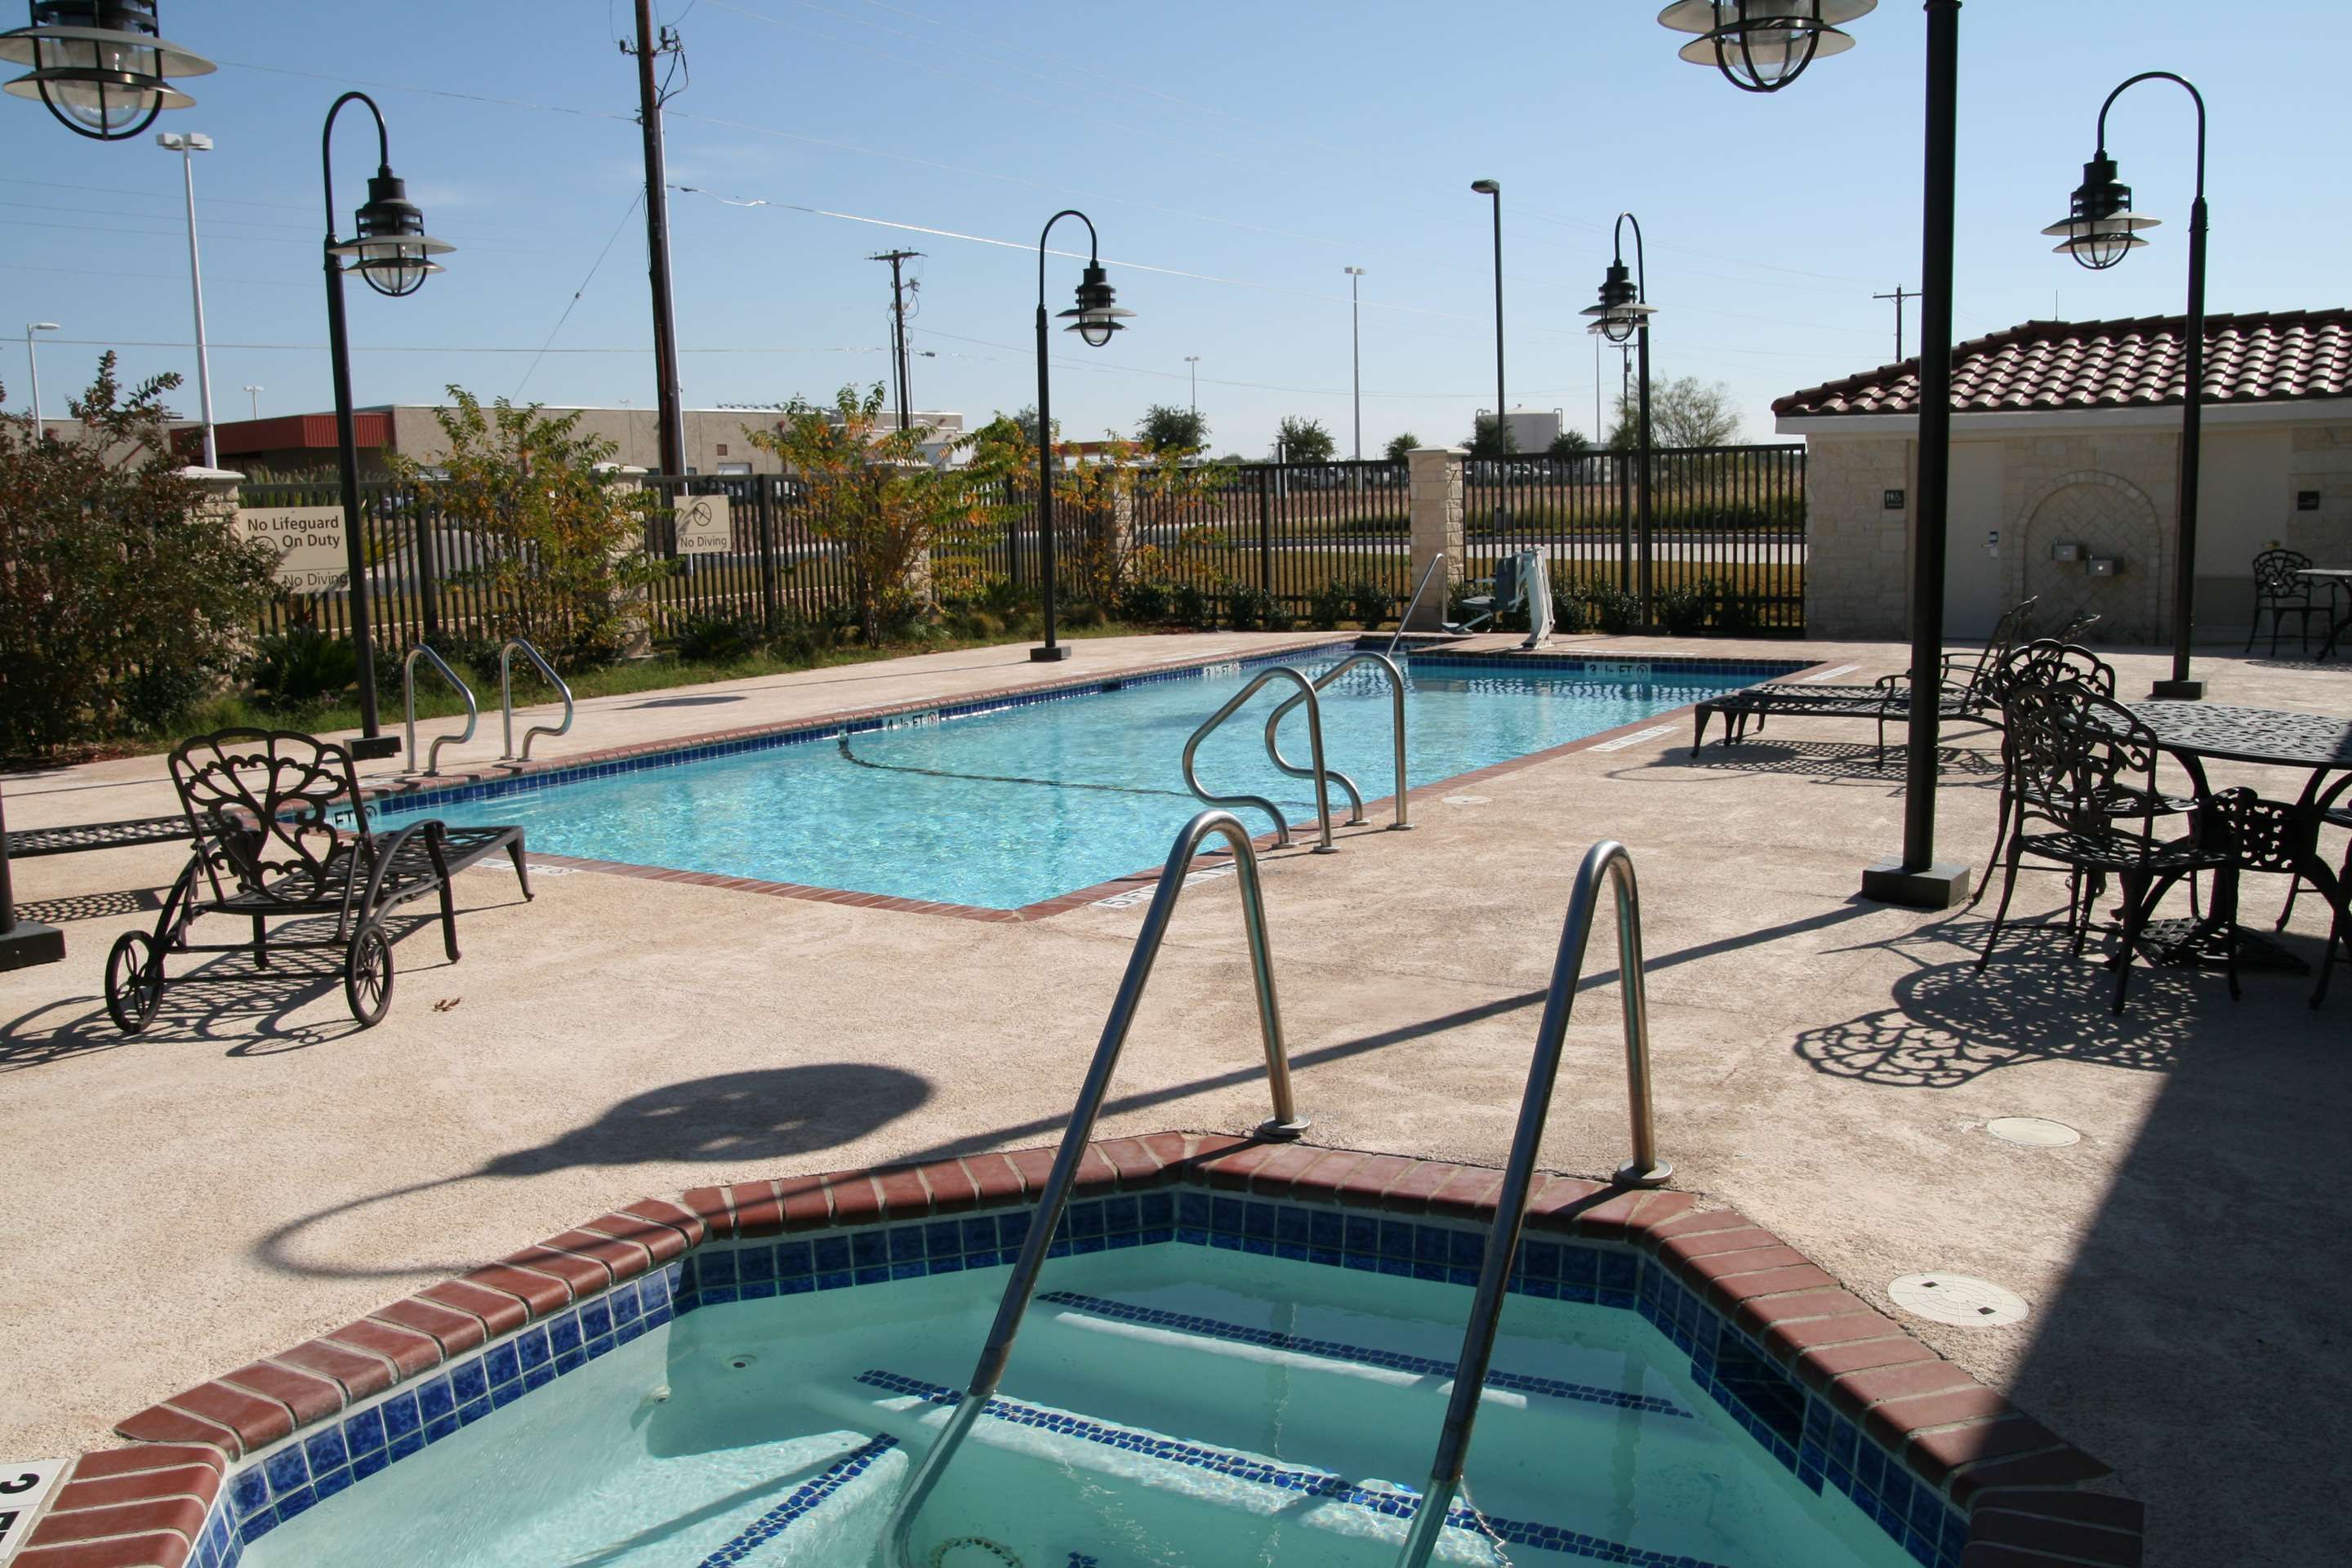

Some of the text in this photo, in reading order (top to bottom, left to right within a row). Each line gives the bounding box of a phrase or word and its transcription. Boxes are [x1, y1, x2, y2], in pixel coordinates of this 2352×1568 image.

[247, 515, 339, 532] No Lifeguard
[282, 534, 341, 549] On Duty
[680, 536, 727, 548] No Diving
[283, 572, 348, 587] No Diving
[1619, 665, 1633, 676] FT
[912, 715, 924, 727] FT
[334, 809, 354, 824] FT
